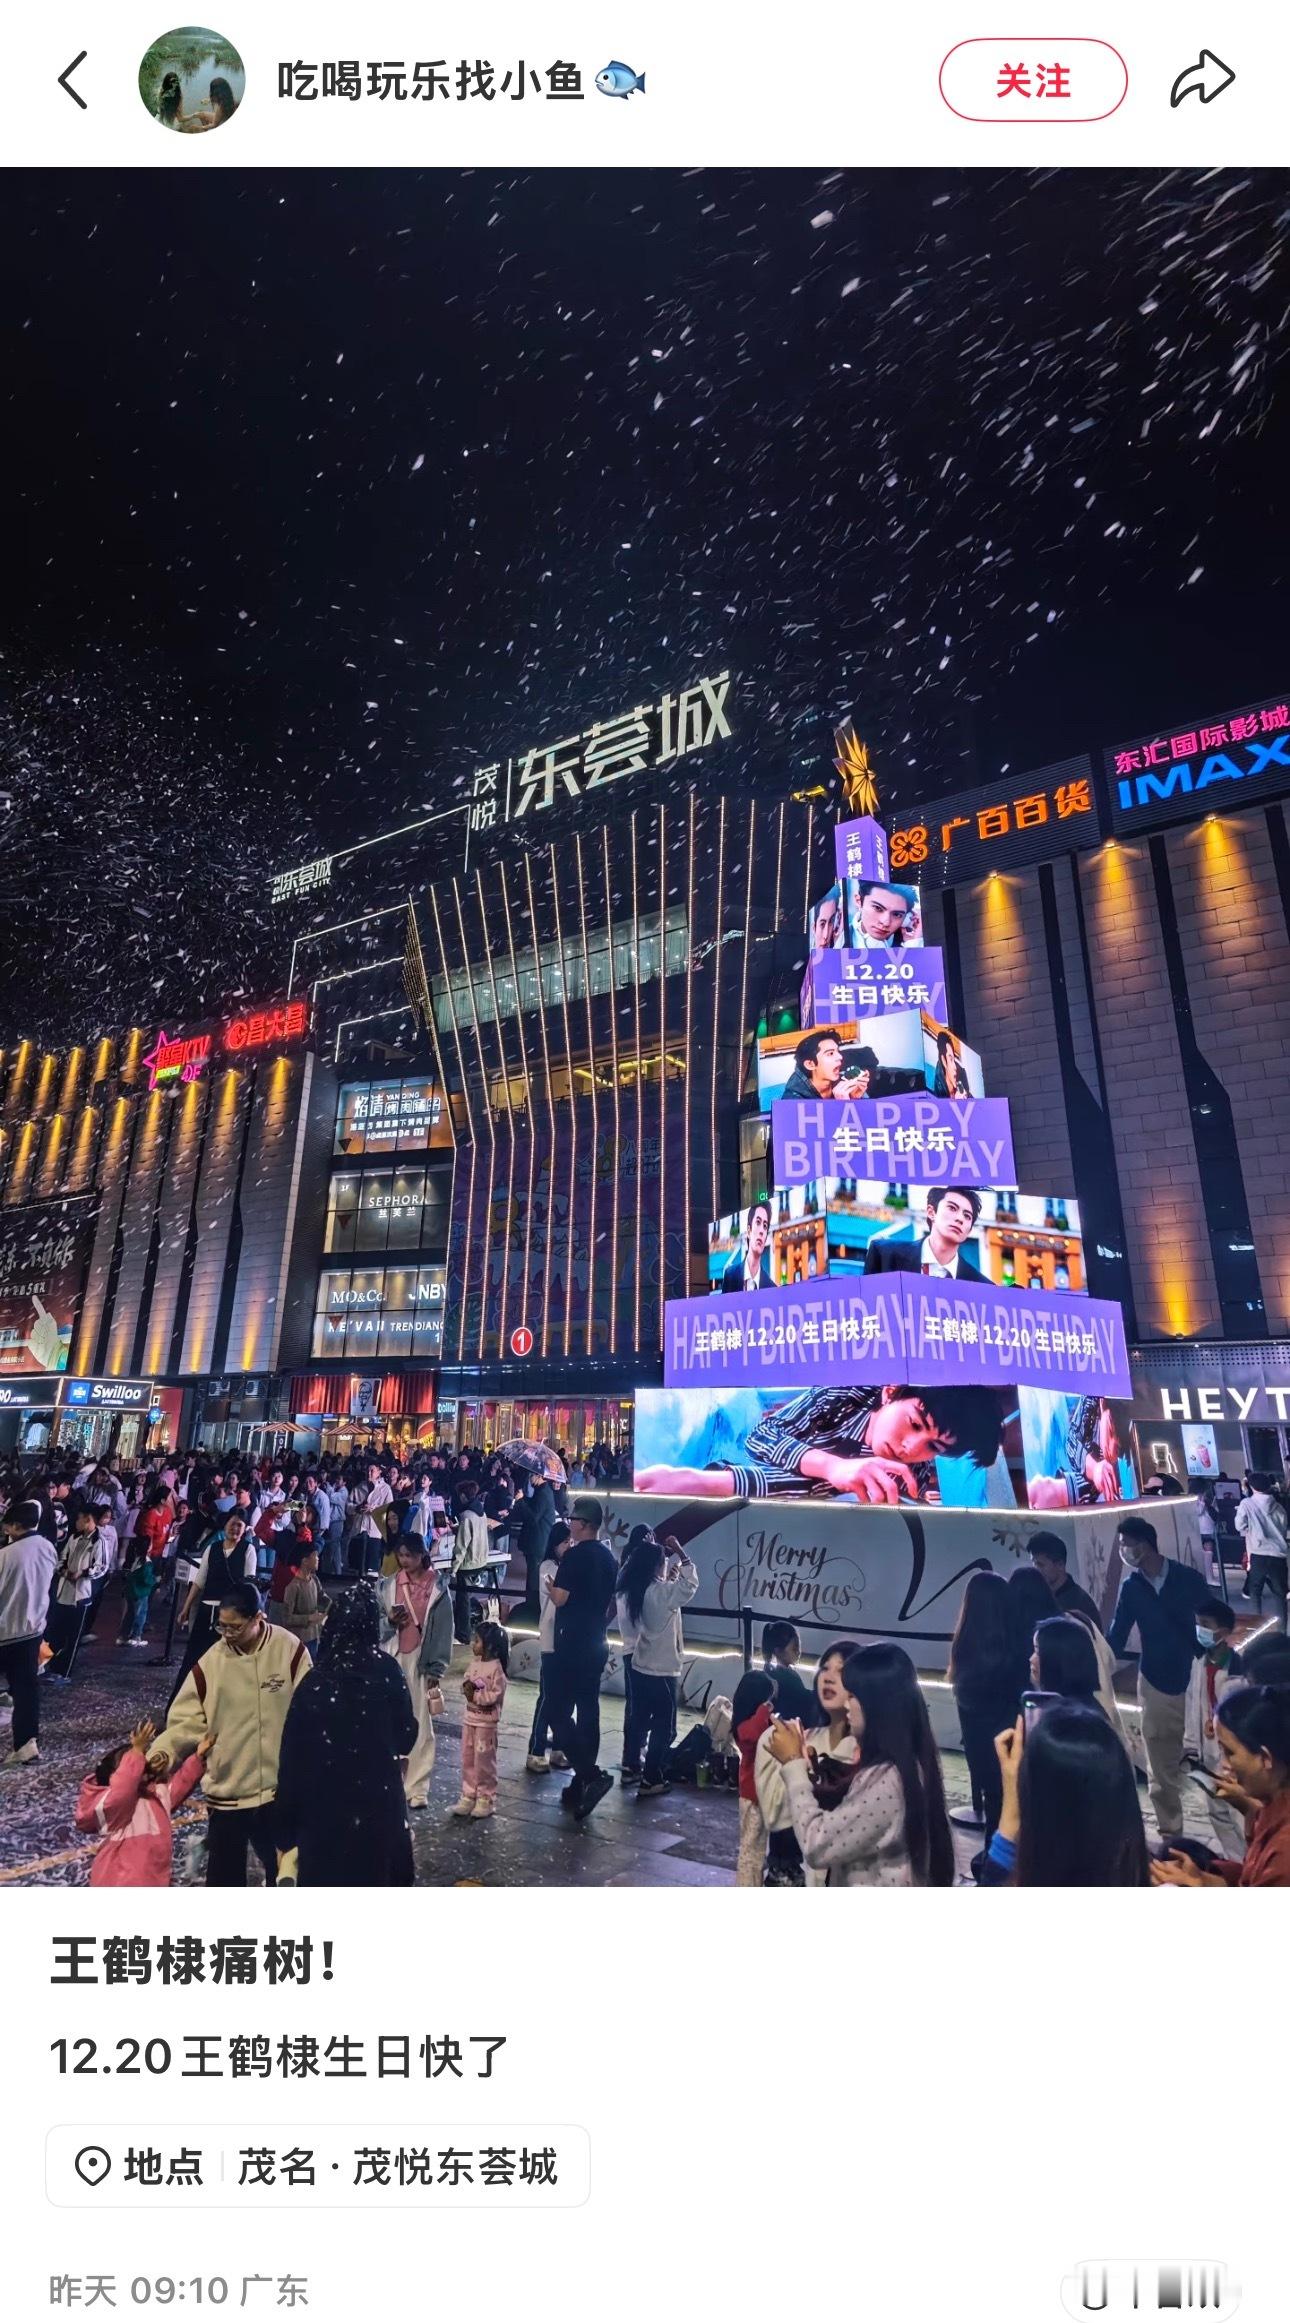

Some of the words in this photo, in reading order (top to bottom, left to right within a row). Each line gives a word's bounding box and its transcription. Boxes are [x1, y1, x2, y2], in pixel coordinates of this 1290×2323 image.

[515, 670, 732, 817] 东荟城
[1114, 704, 1290, 775] 东汇国际影城
[1118, 735, 1290, 810] IMAX
[473, 763, 500, 831] 茂悦
[942, 779, 1092, 851] 广百百货
[846, 831, 863, 878] 王鹤棣
[272, 892, 291, 904] EAST
[295, 884, 310, 895] FUN
[313, 877, 331, 889] CITY
[845, 963, 914, 981] 12.20
[832, 984, 930, 1006] 生日快乐
[248, 1003, 304, 1046] 昌大昌
[796, 1101, 976, 1138] HAPPY
[832, 1126, 956, 1153] 生日快乐
[784, 1140, 1005, 1179] BIRTHDAY
[368, 1194, 428, 1207] SEPHORA
[331, 1289, 386, 1304] MO&Co.
[695, 1328, 742, 1352] 王鹤棣
[747, 1326, 797, 1348] 12.20
[802, 1314, 882, 1346] 生日快乐
[924, 1315, 979, 1345] 王鹤棣
[983, 1324, 1031, 1348] 12.20
[1035, 1328, 1097, 1356] 生日快乐
[92, 1385, 141, 1399] Swilloo
[1160, 1387, 1290, 1420] HEYT
[746, 1530, 845, 1583] Merry
[716, 1561, 859, 1619] Christmas
